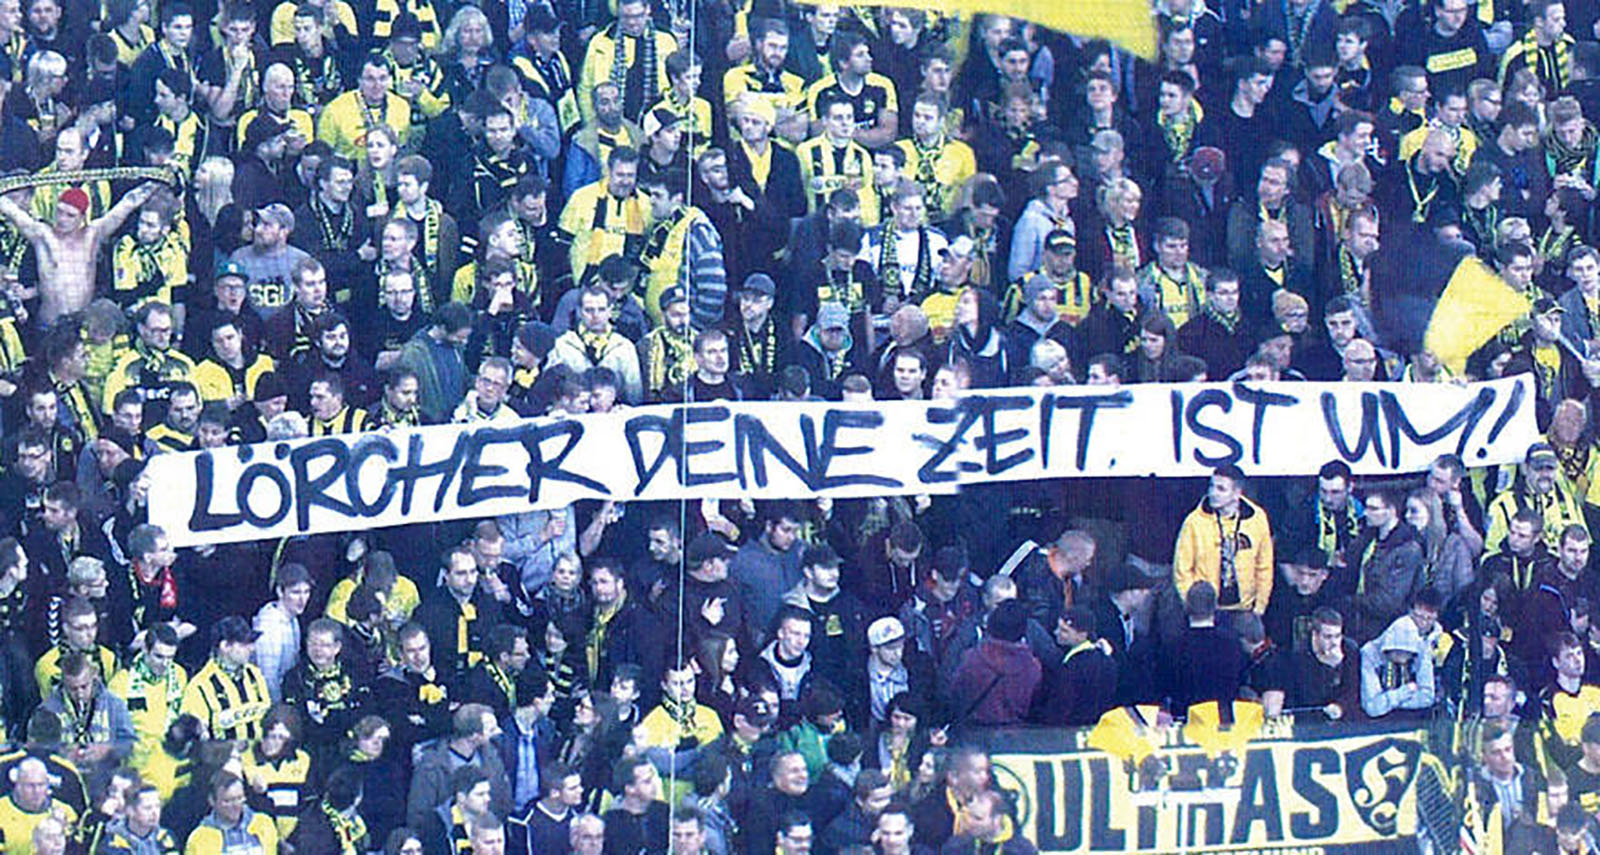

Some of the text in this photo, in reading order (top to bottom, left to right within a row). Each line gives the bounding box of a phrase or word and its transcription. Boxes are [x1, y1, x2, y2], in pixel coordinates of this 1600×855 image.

[189, 418, 612, 532] LÖRCHER
[624, 405, 905, 496] DEINE
[1170, 382, 1300, 468] IST
[1319, 378, 1527, 470] UM!
